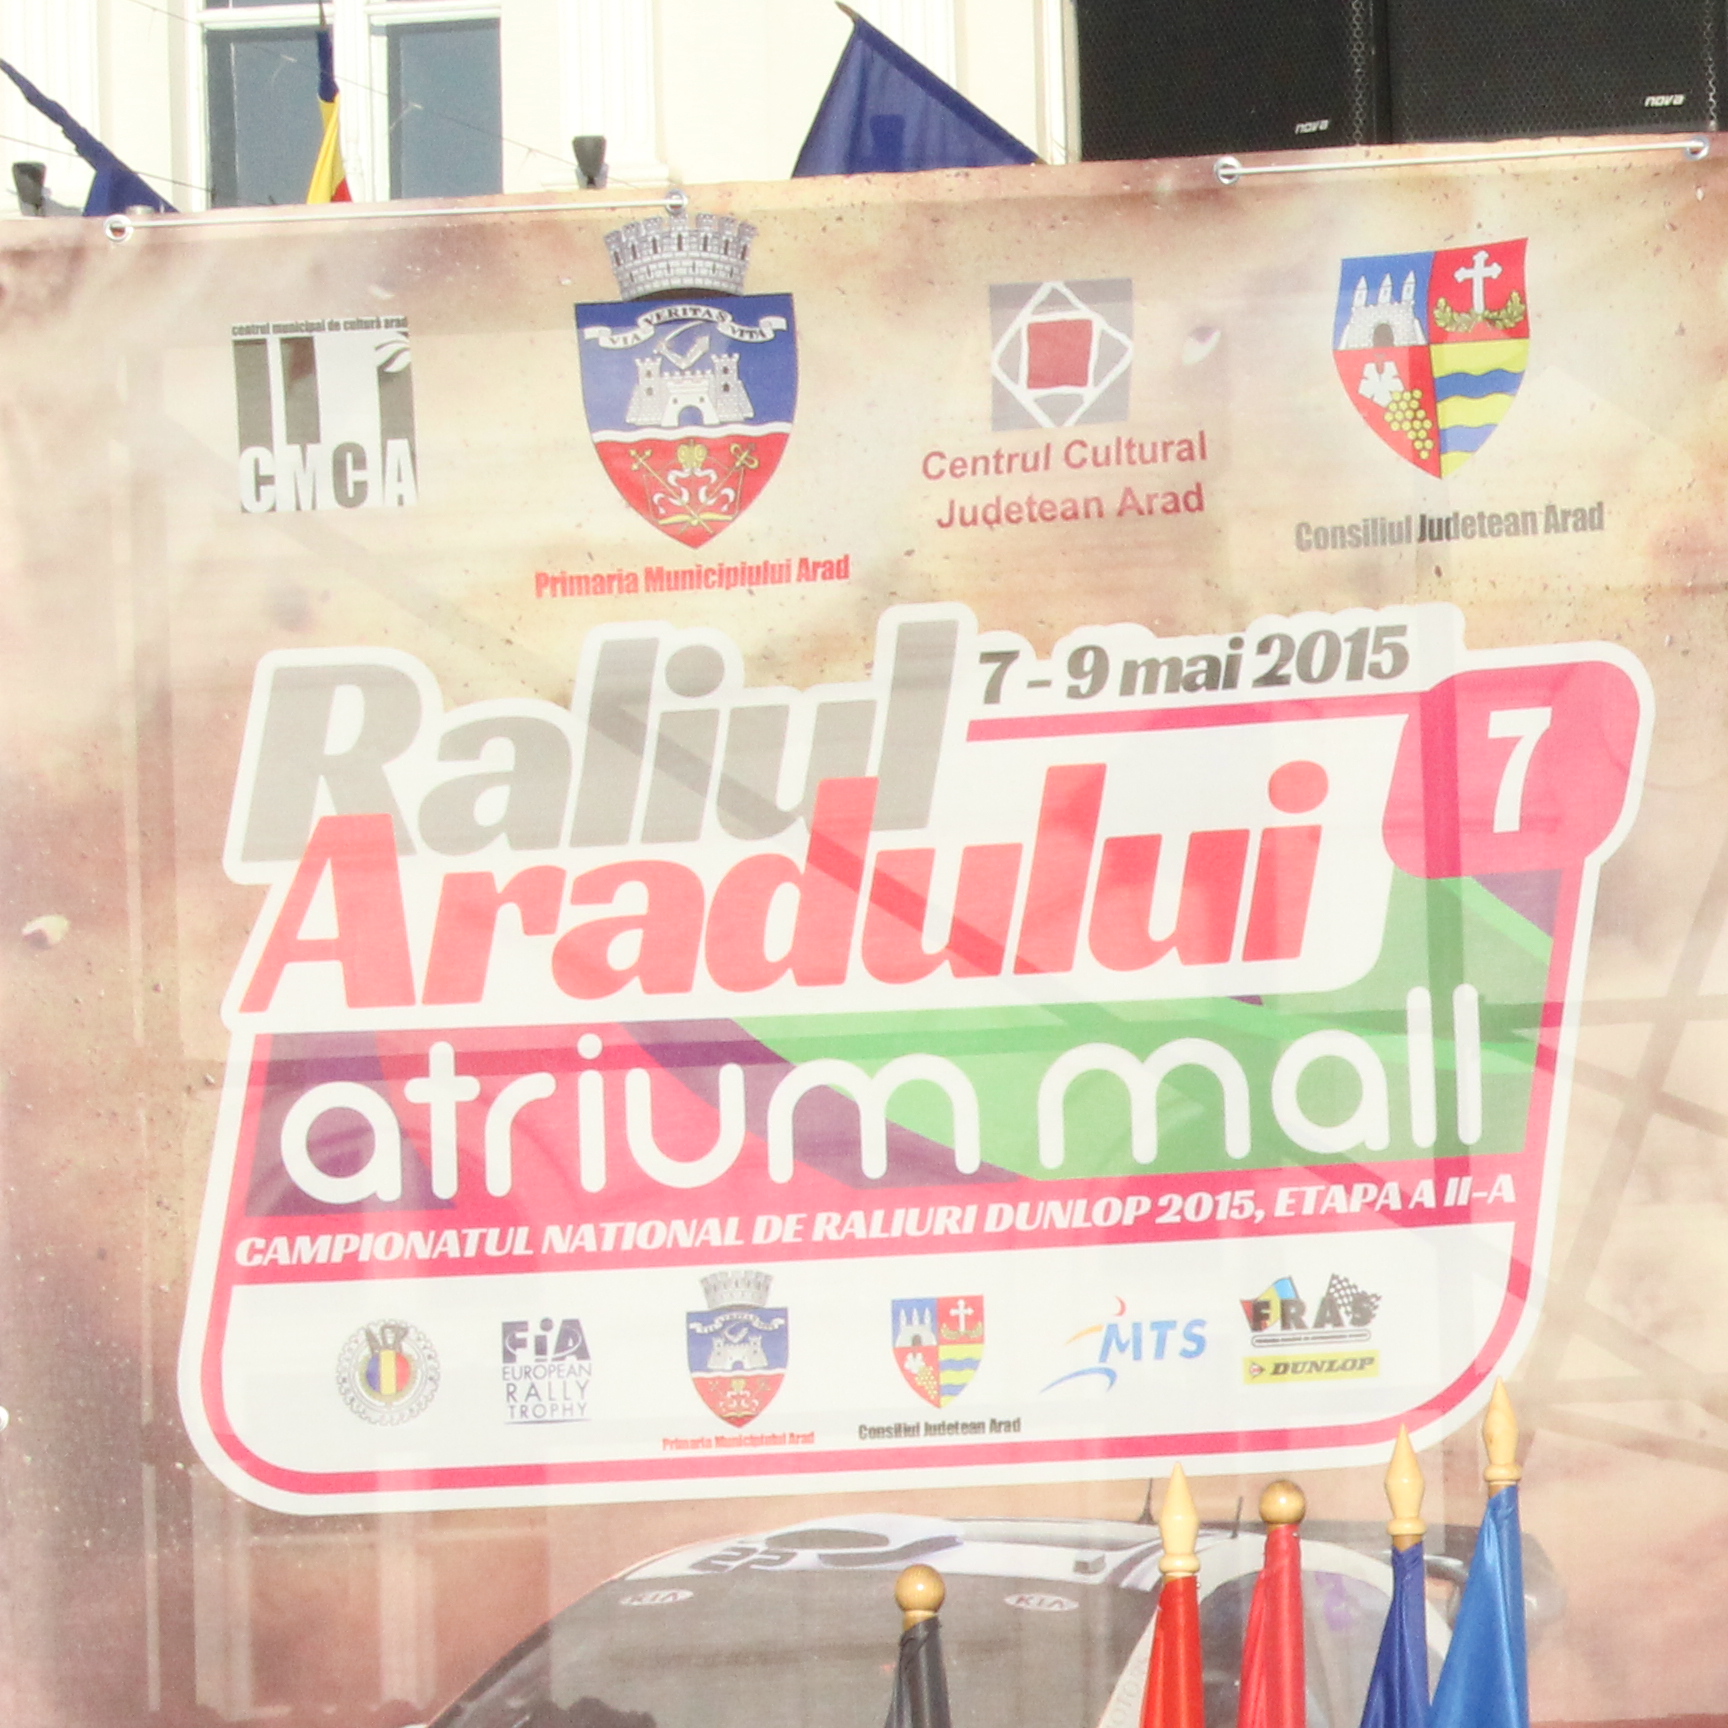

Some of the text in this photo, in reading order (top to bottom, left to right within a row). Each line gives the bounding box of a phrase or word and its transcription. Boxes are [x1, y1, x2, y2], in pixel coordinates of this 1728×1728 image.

[642, 305, 729, 326] VERITAS
[240, 438, 418, 513] CMCA
[921, 430, 1208, 481] Centrul Cultural
[1116, 482, 1206, 518] Arad
[1294, 501, 1606, 554] Consiliul Judetean Arad
[535, 554, 850, 599] Primaria Municipiului Arad
[977, 622, 1411, 704] 7 9 mai 2015
[240, 617, 960, 863] Raliul
[1486, 705, 1553, 834] 7
[237, 759, 1330, 1014] Aradului
[280, 982, 1482, 1205] atrium mall
[235, 1171, 1517, 1268] CAMPIONATUL NATIONAL DE RALIURI DUNLOP 2015, ETAPA A II-A
[1098, 1318, 1208, 1363] MTS
[502, 1363, 592, 1381] EUROPEAN
[1269, 1357, 1376, 1377] DUNLOP
[506, 1380, 589, 1403] RALLY
[508, 1403, 588, 1419] TROPHY
[988, 1416, 1022, 1434] Arad
